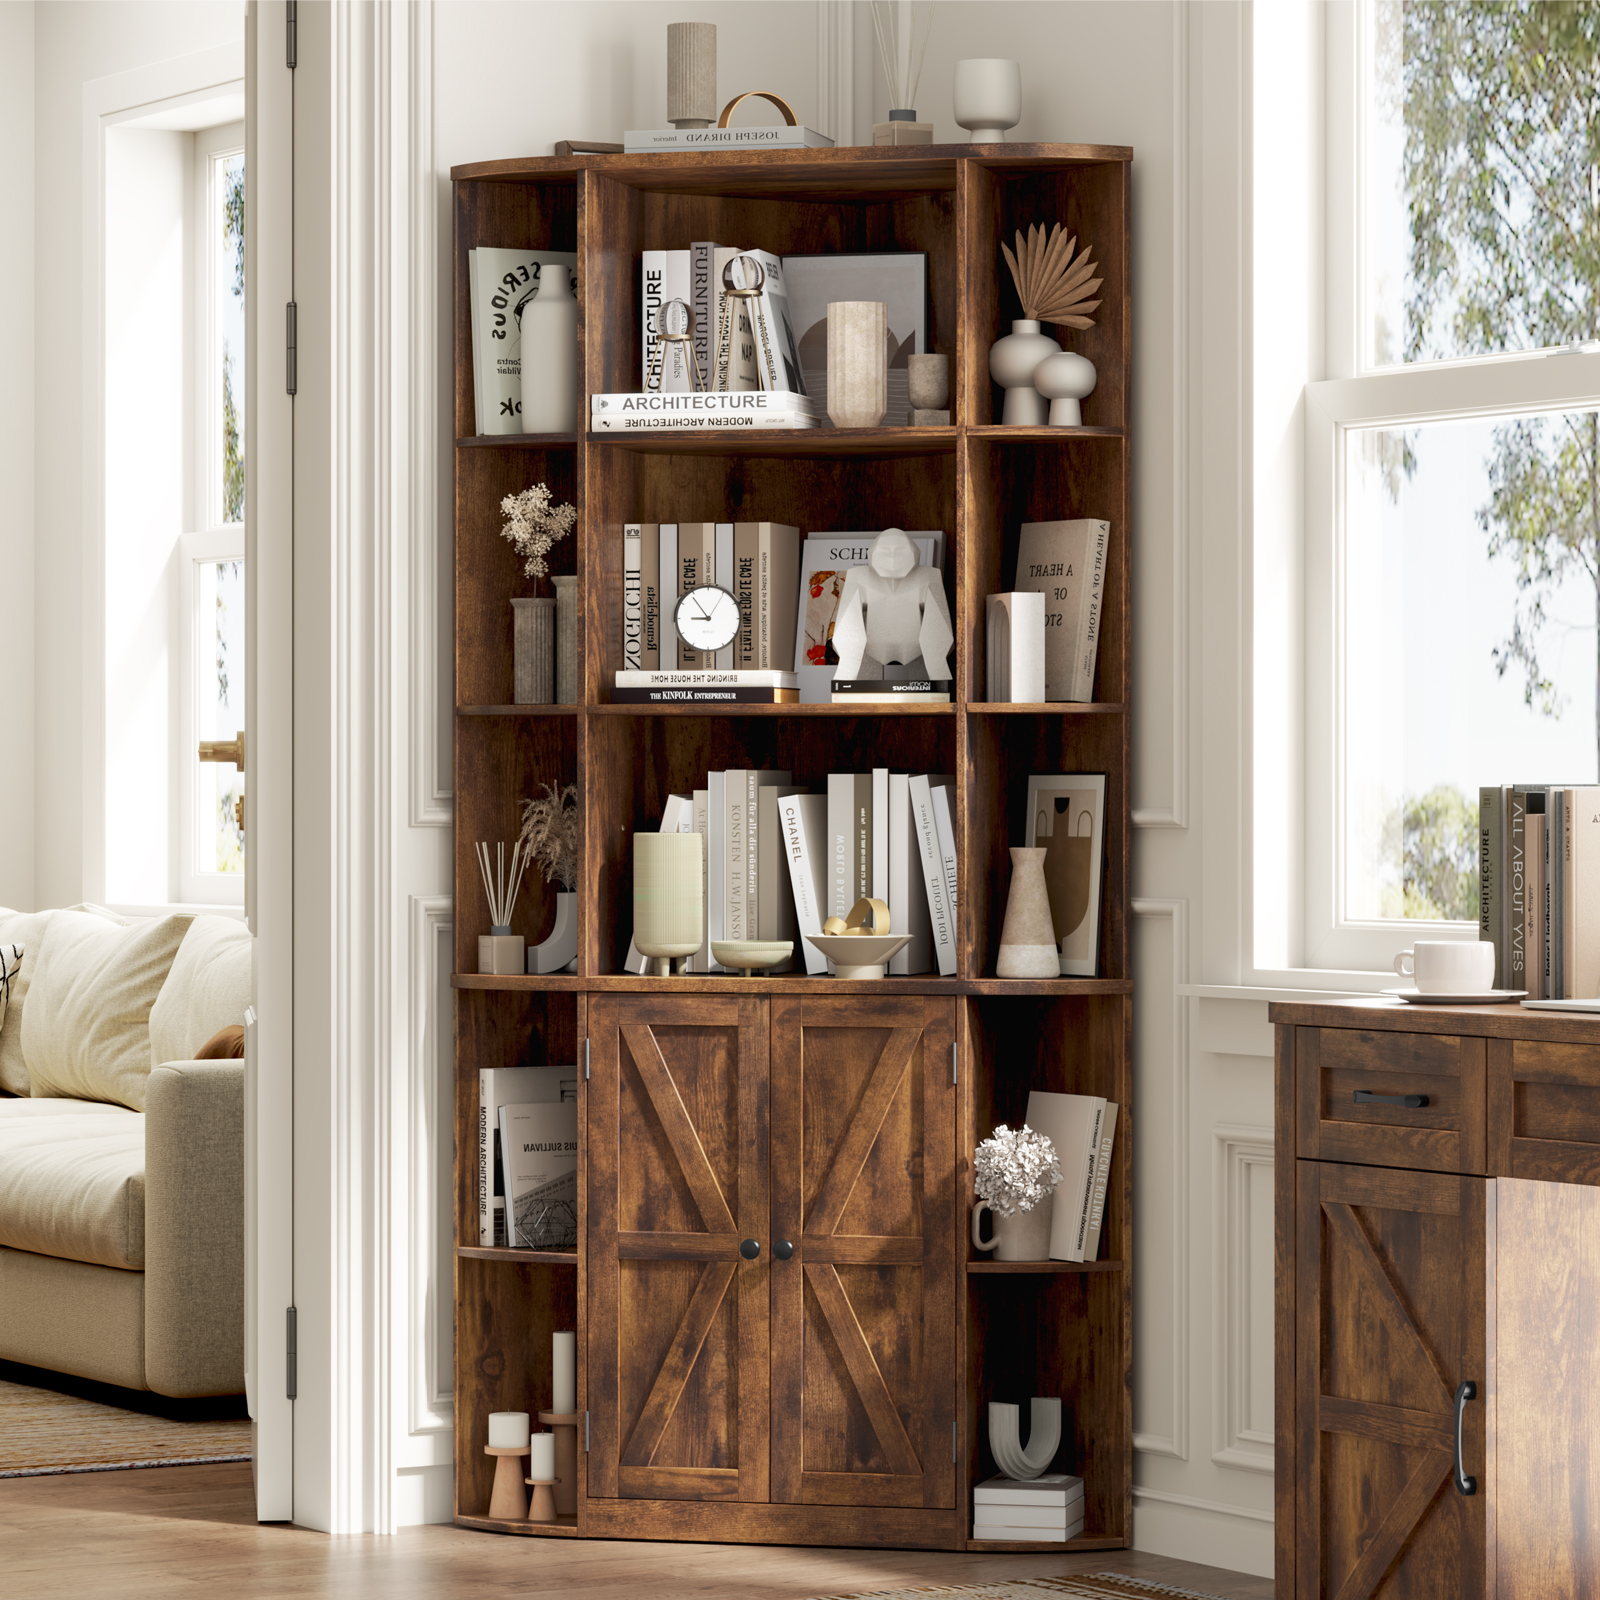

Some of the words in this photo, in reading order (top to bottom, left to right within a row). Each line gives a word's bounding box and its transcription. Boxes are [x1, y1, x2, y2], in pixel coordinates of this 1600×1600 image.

[695, 245, 708, 361] FURNITURE
[646, 269, 662, 393] CHITECTURE
[673, 346, 684, 379] Paradies
[622, 394, 768, 411] ARCHITECTURE
[624, 417, 705, 427] ARCHITECTURE
[707, 416, 753, 426] MODERN
[662, 691, 693, 700] KINFOLK
[694, 692, 737, 700] ENTREPRENEUR
[731, 804, 741, 863] KONSTEN
[785, 807, 803, 863] CHANEL
[1512, 802, 1524, 838] ALL
[749, 838, 757, 851] die
[1482, 828, 1490, 932] ARCHITECTURE
[1512, 844, 1524, 915] ABOUT
[1512, 923, 1524, 972] YVES
[479, 1106, 487, 1145] MODERN
[479, 1147, 487, 1216] ARCHITECTURE
